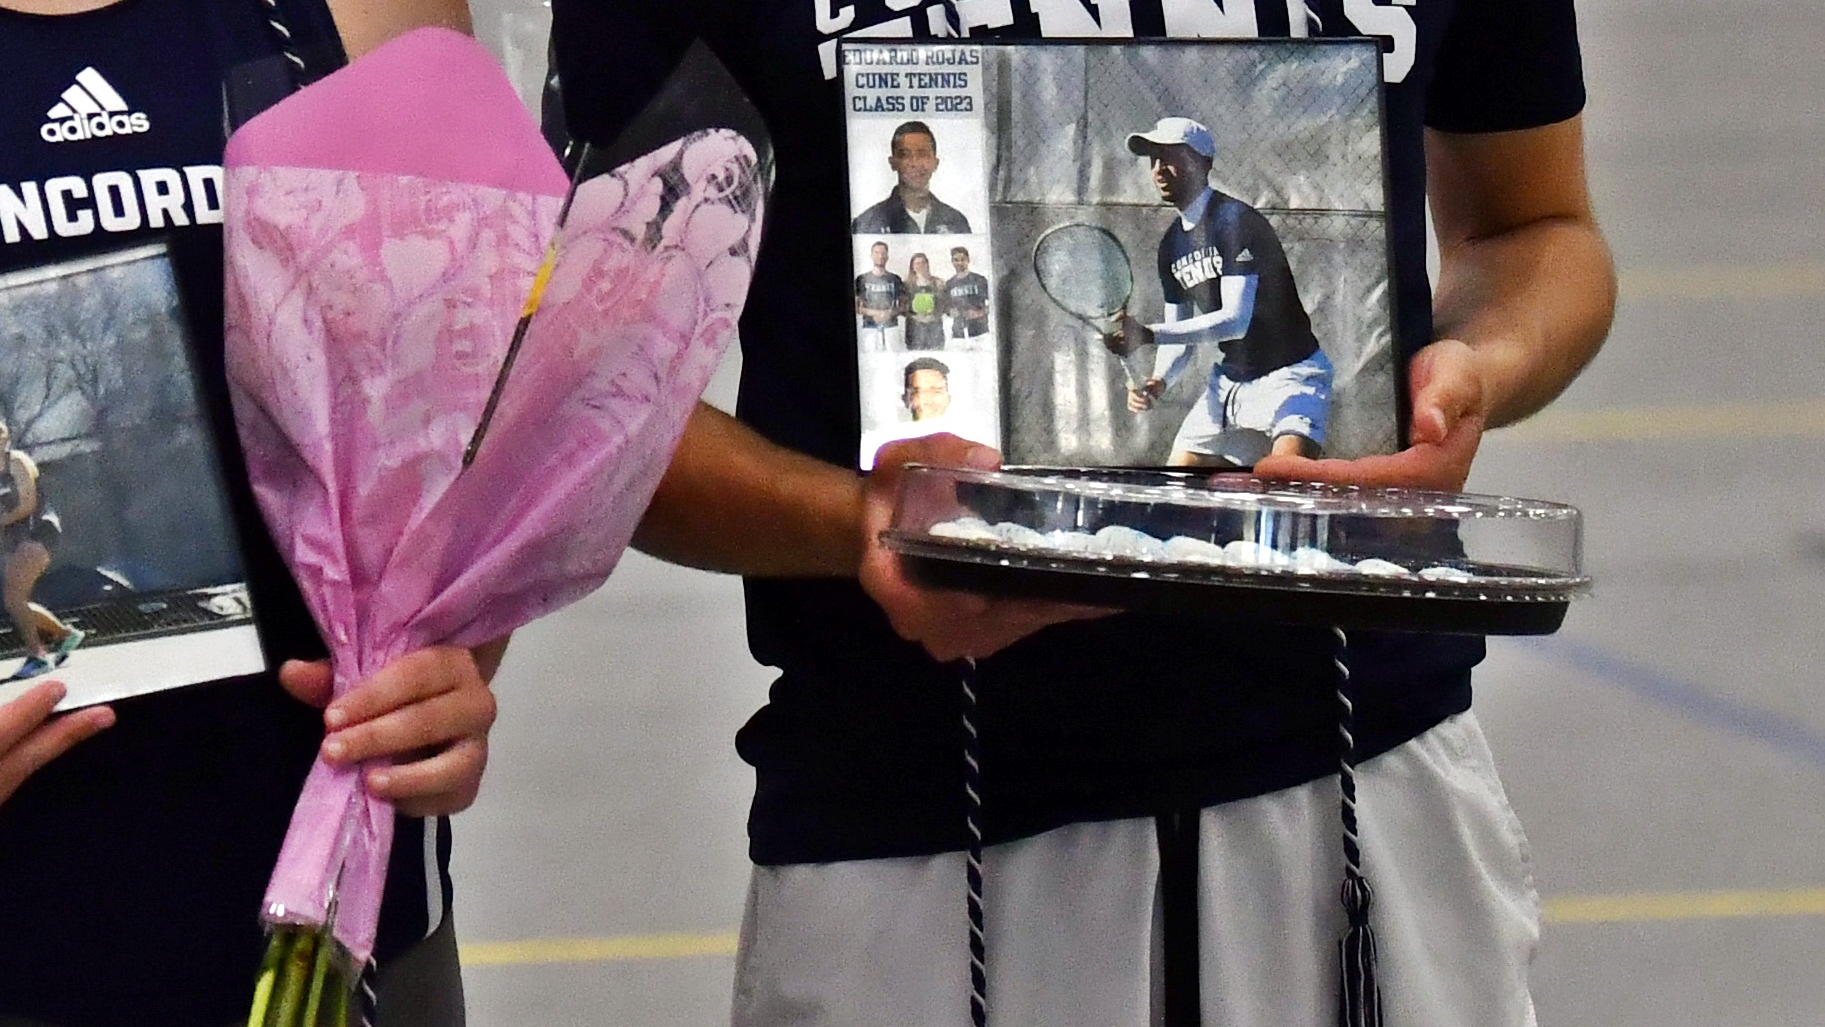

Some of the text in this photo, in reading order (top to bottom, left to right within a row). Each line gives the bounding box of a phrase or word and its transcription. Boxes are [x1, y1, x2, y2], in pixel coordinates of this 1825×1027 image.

[924, 48, 980, 65] ROJAS
[855, 72, 968, 89] CUNE TENNIS
[852, 95, 973, 112] CLASS OF 2023
[40, 111, 151, 143] adidas
